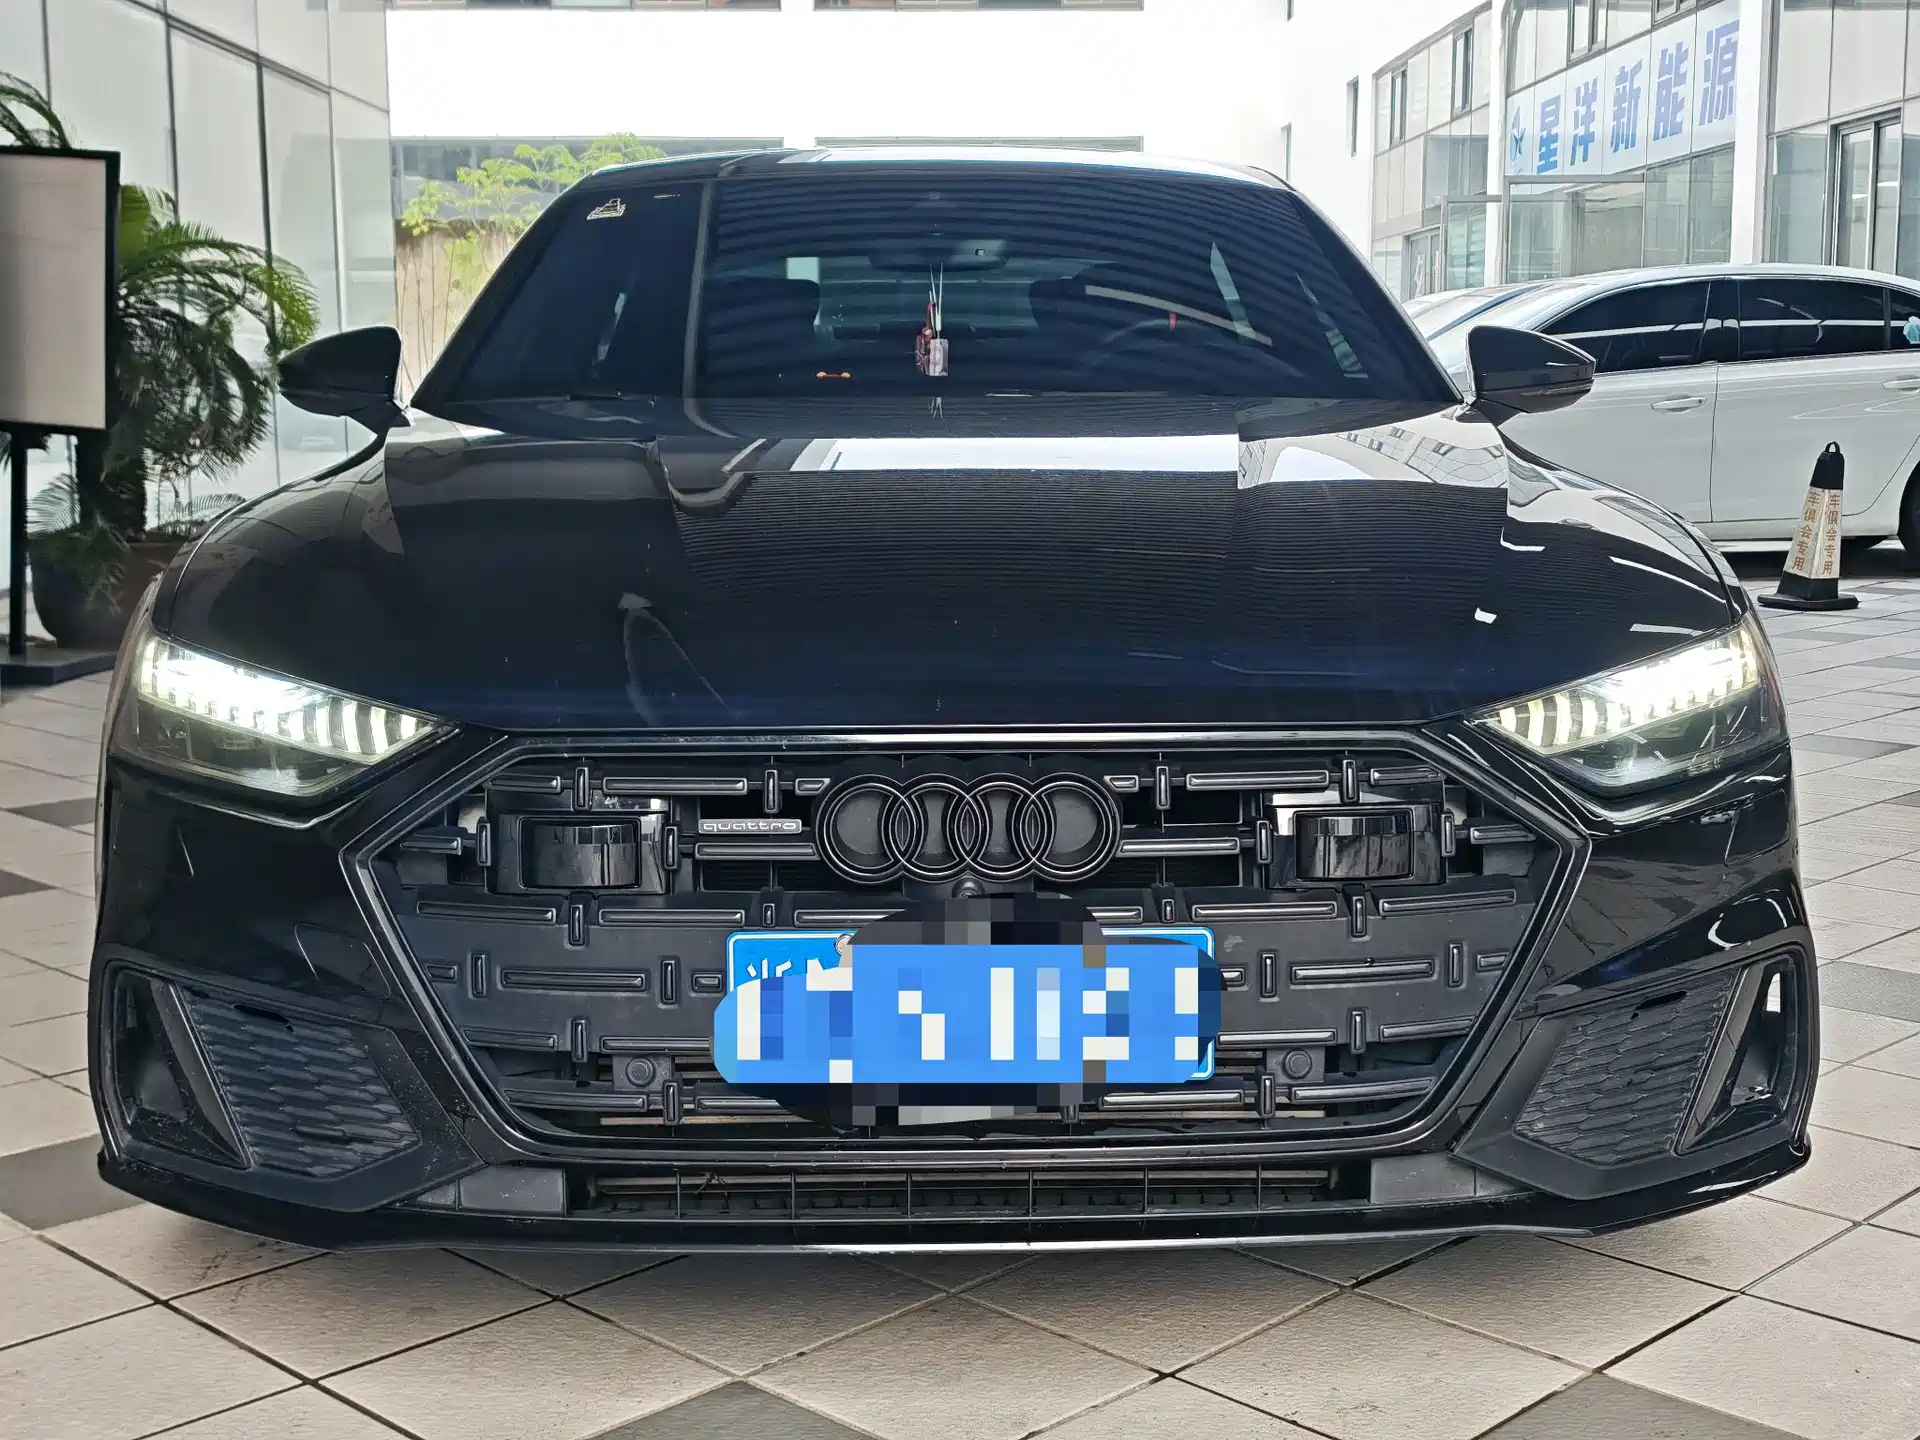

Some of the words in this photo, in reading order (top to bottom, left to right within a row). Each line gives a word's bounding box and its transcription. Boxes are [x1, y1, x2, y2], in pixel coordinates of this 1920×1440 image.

[1536, 20, 1739, 174] 星洋新能源
[703, 821, 797, 832] quattro
